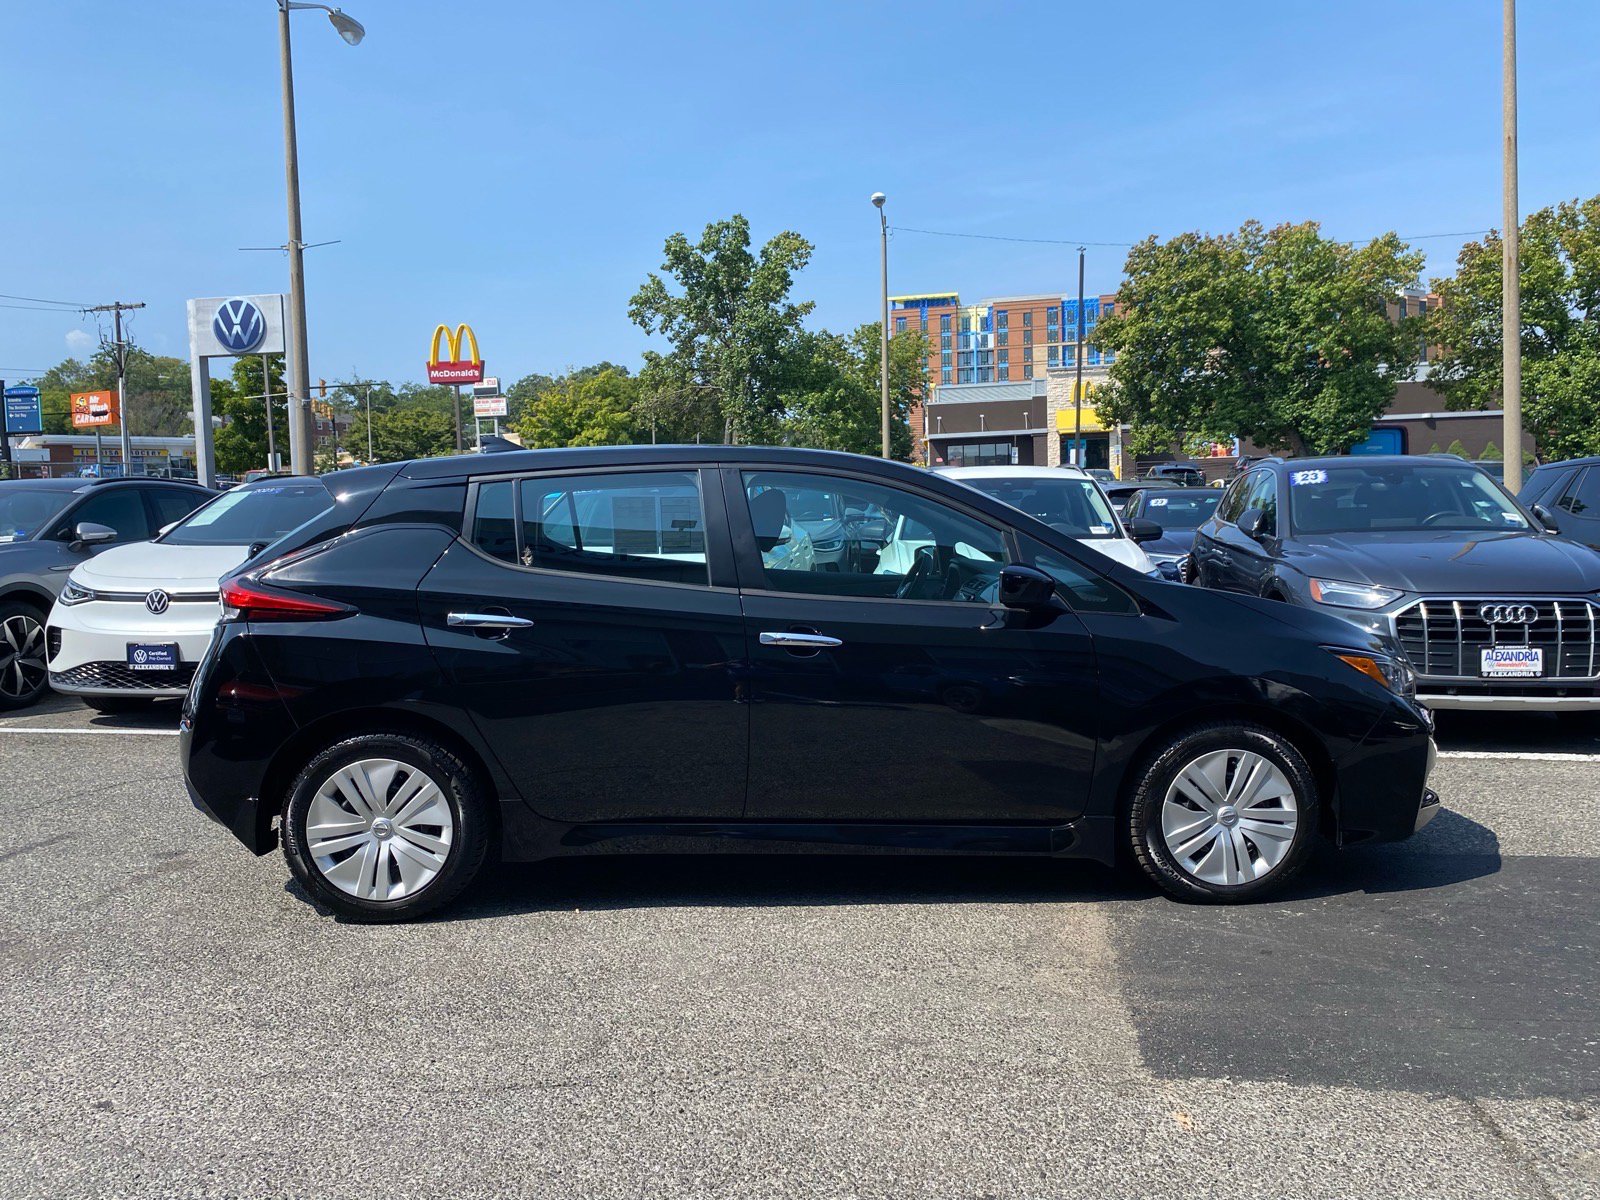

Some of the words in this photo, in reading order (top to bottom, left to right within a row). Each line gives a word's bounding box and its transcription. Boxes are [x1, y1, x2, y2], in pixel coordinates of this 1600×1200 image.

[430, 369, 480, 378] McDonald's
[89, 395, 100, 404] Mr
[1300, 472, 1319, 481] 23
[1484, 651, 1539, 662] ALEXANDRIA
